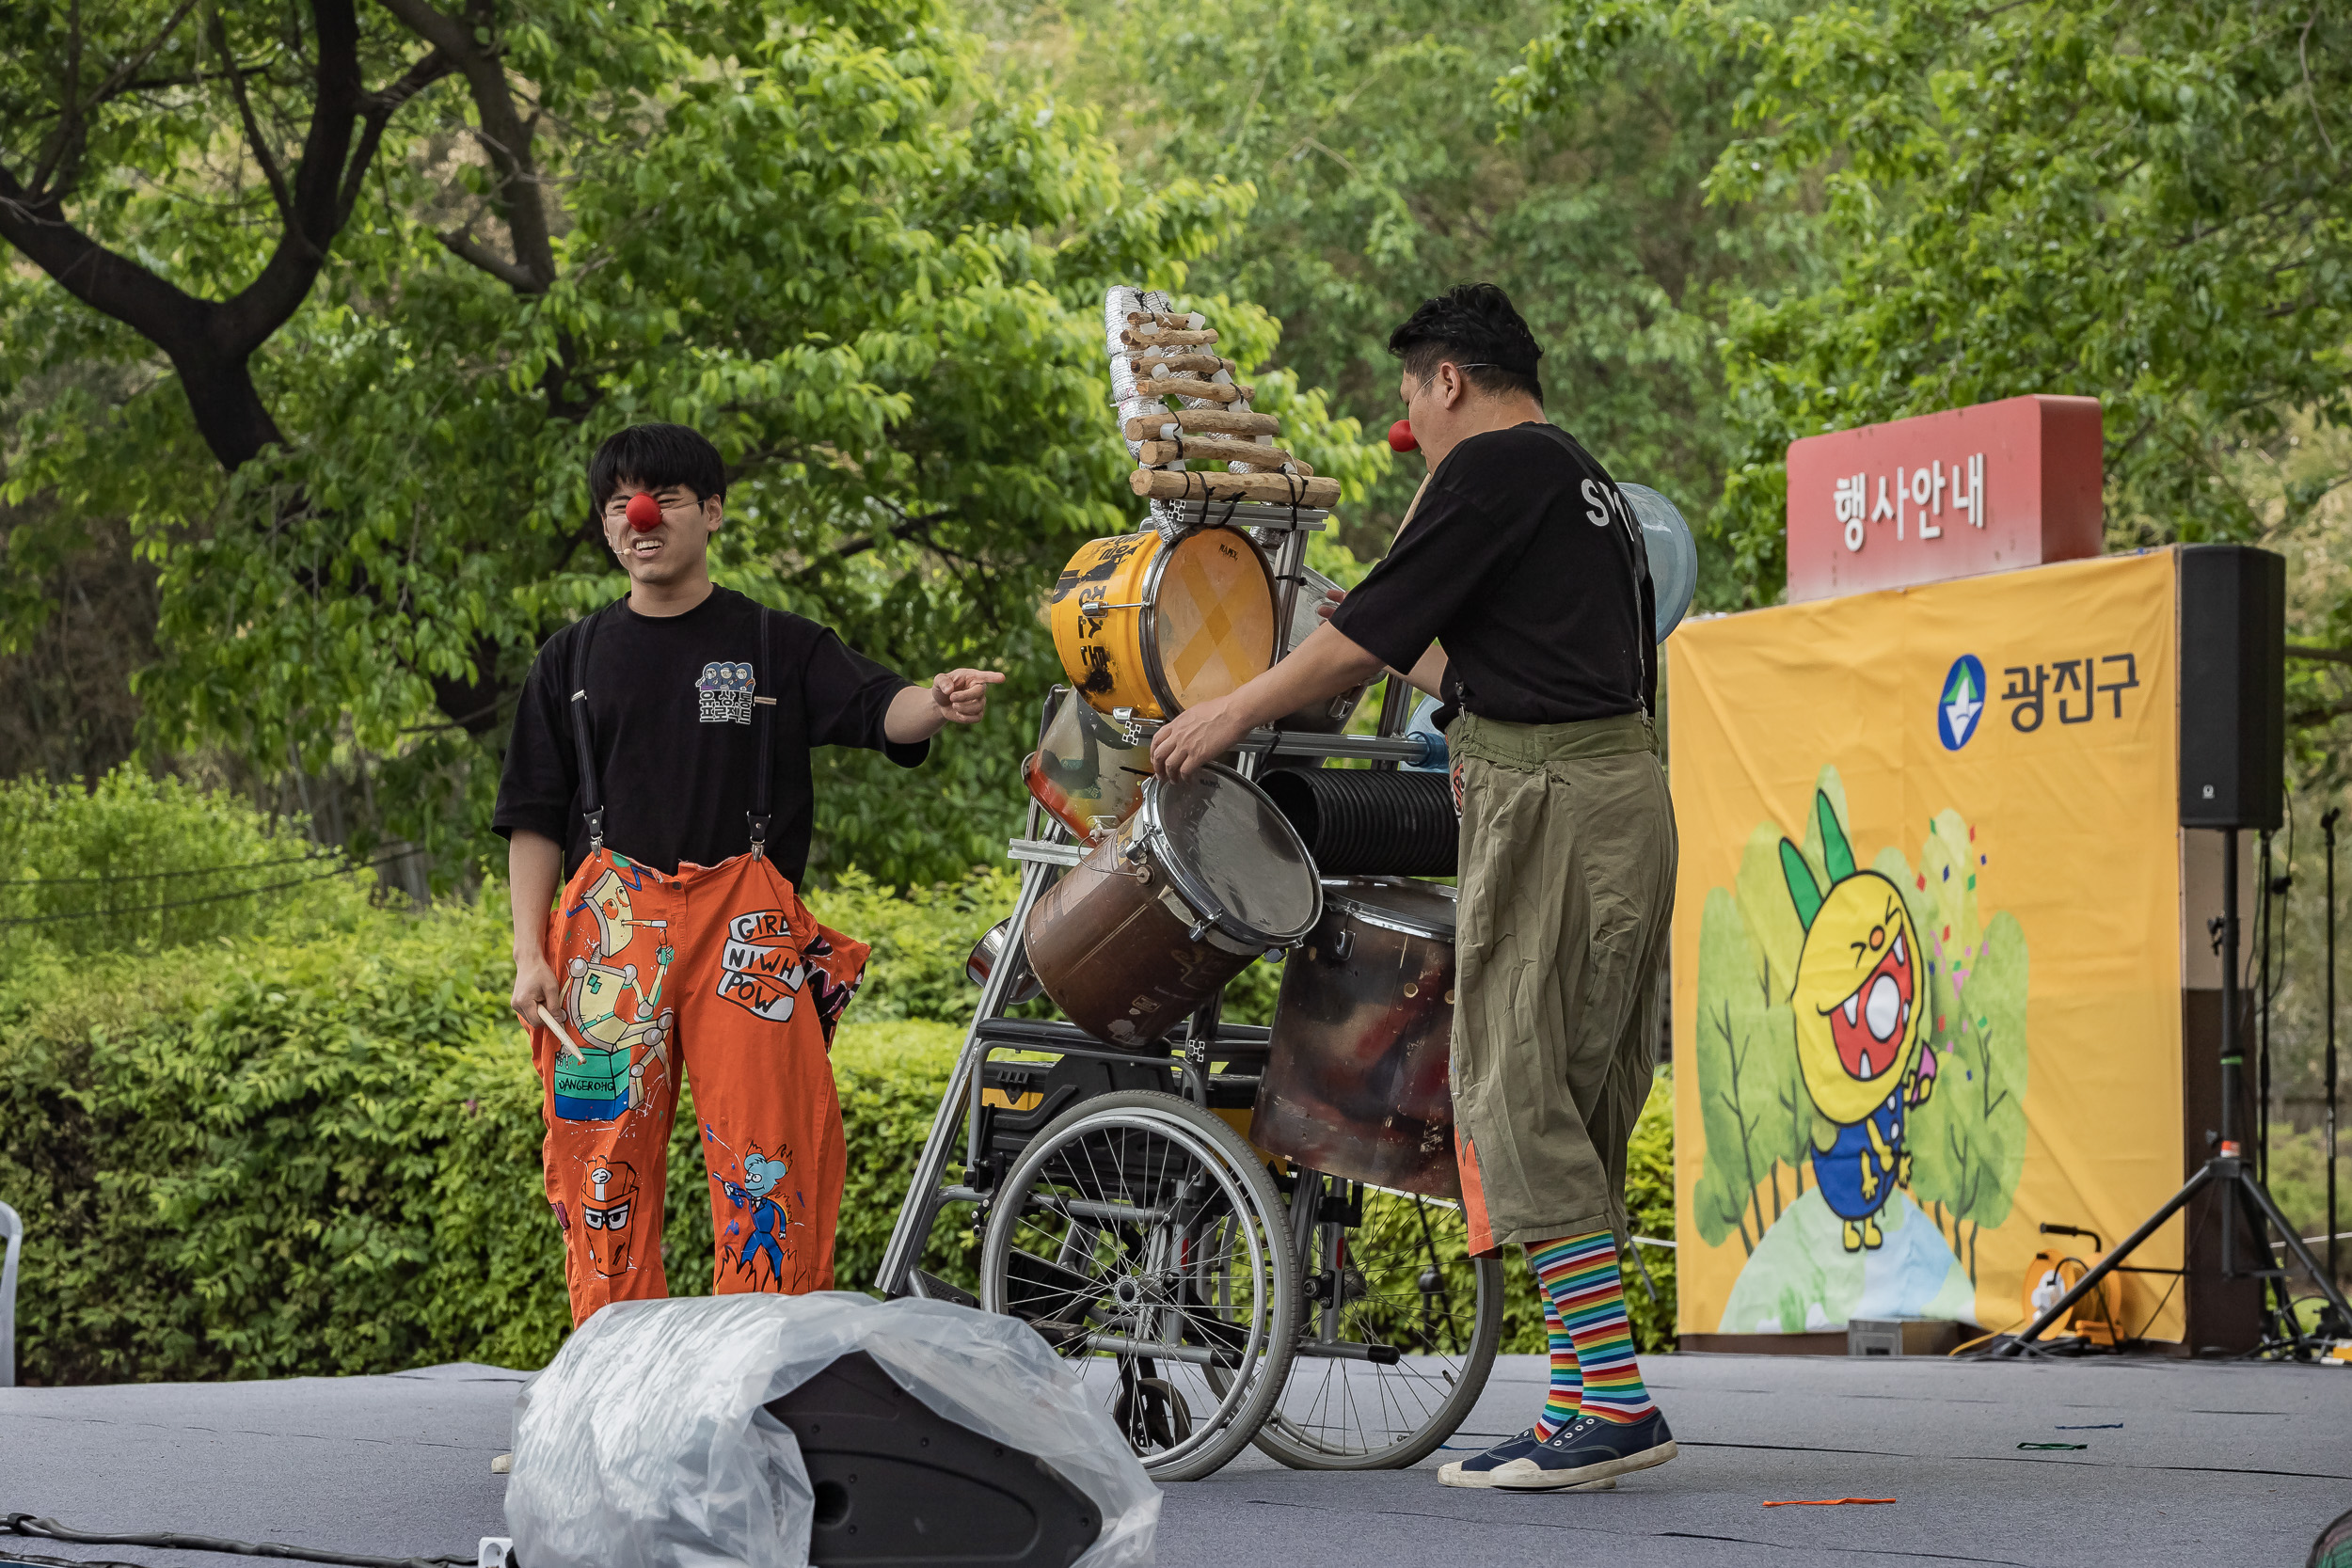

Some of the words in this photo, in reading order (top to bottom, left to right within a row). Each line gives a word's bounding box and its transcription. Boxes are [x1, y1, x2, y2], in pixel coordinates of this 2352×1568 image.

[1833, 451, 1987, 552] 행사안내
[2002, 653, 2140, 733] 광진구
[699, 705, 752, 725] 프로젝트
[728, 947, 797, 980] NIWH
[723, 971, 781, 1014] POW
